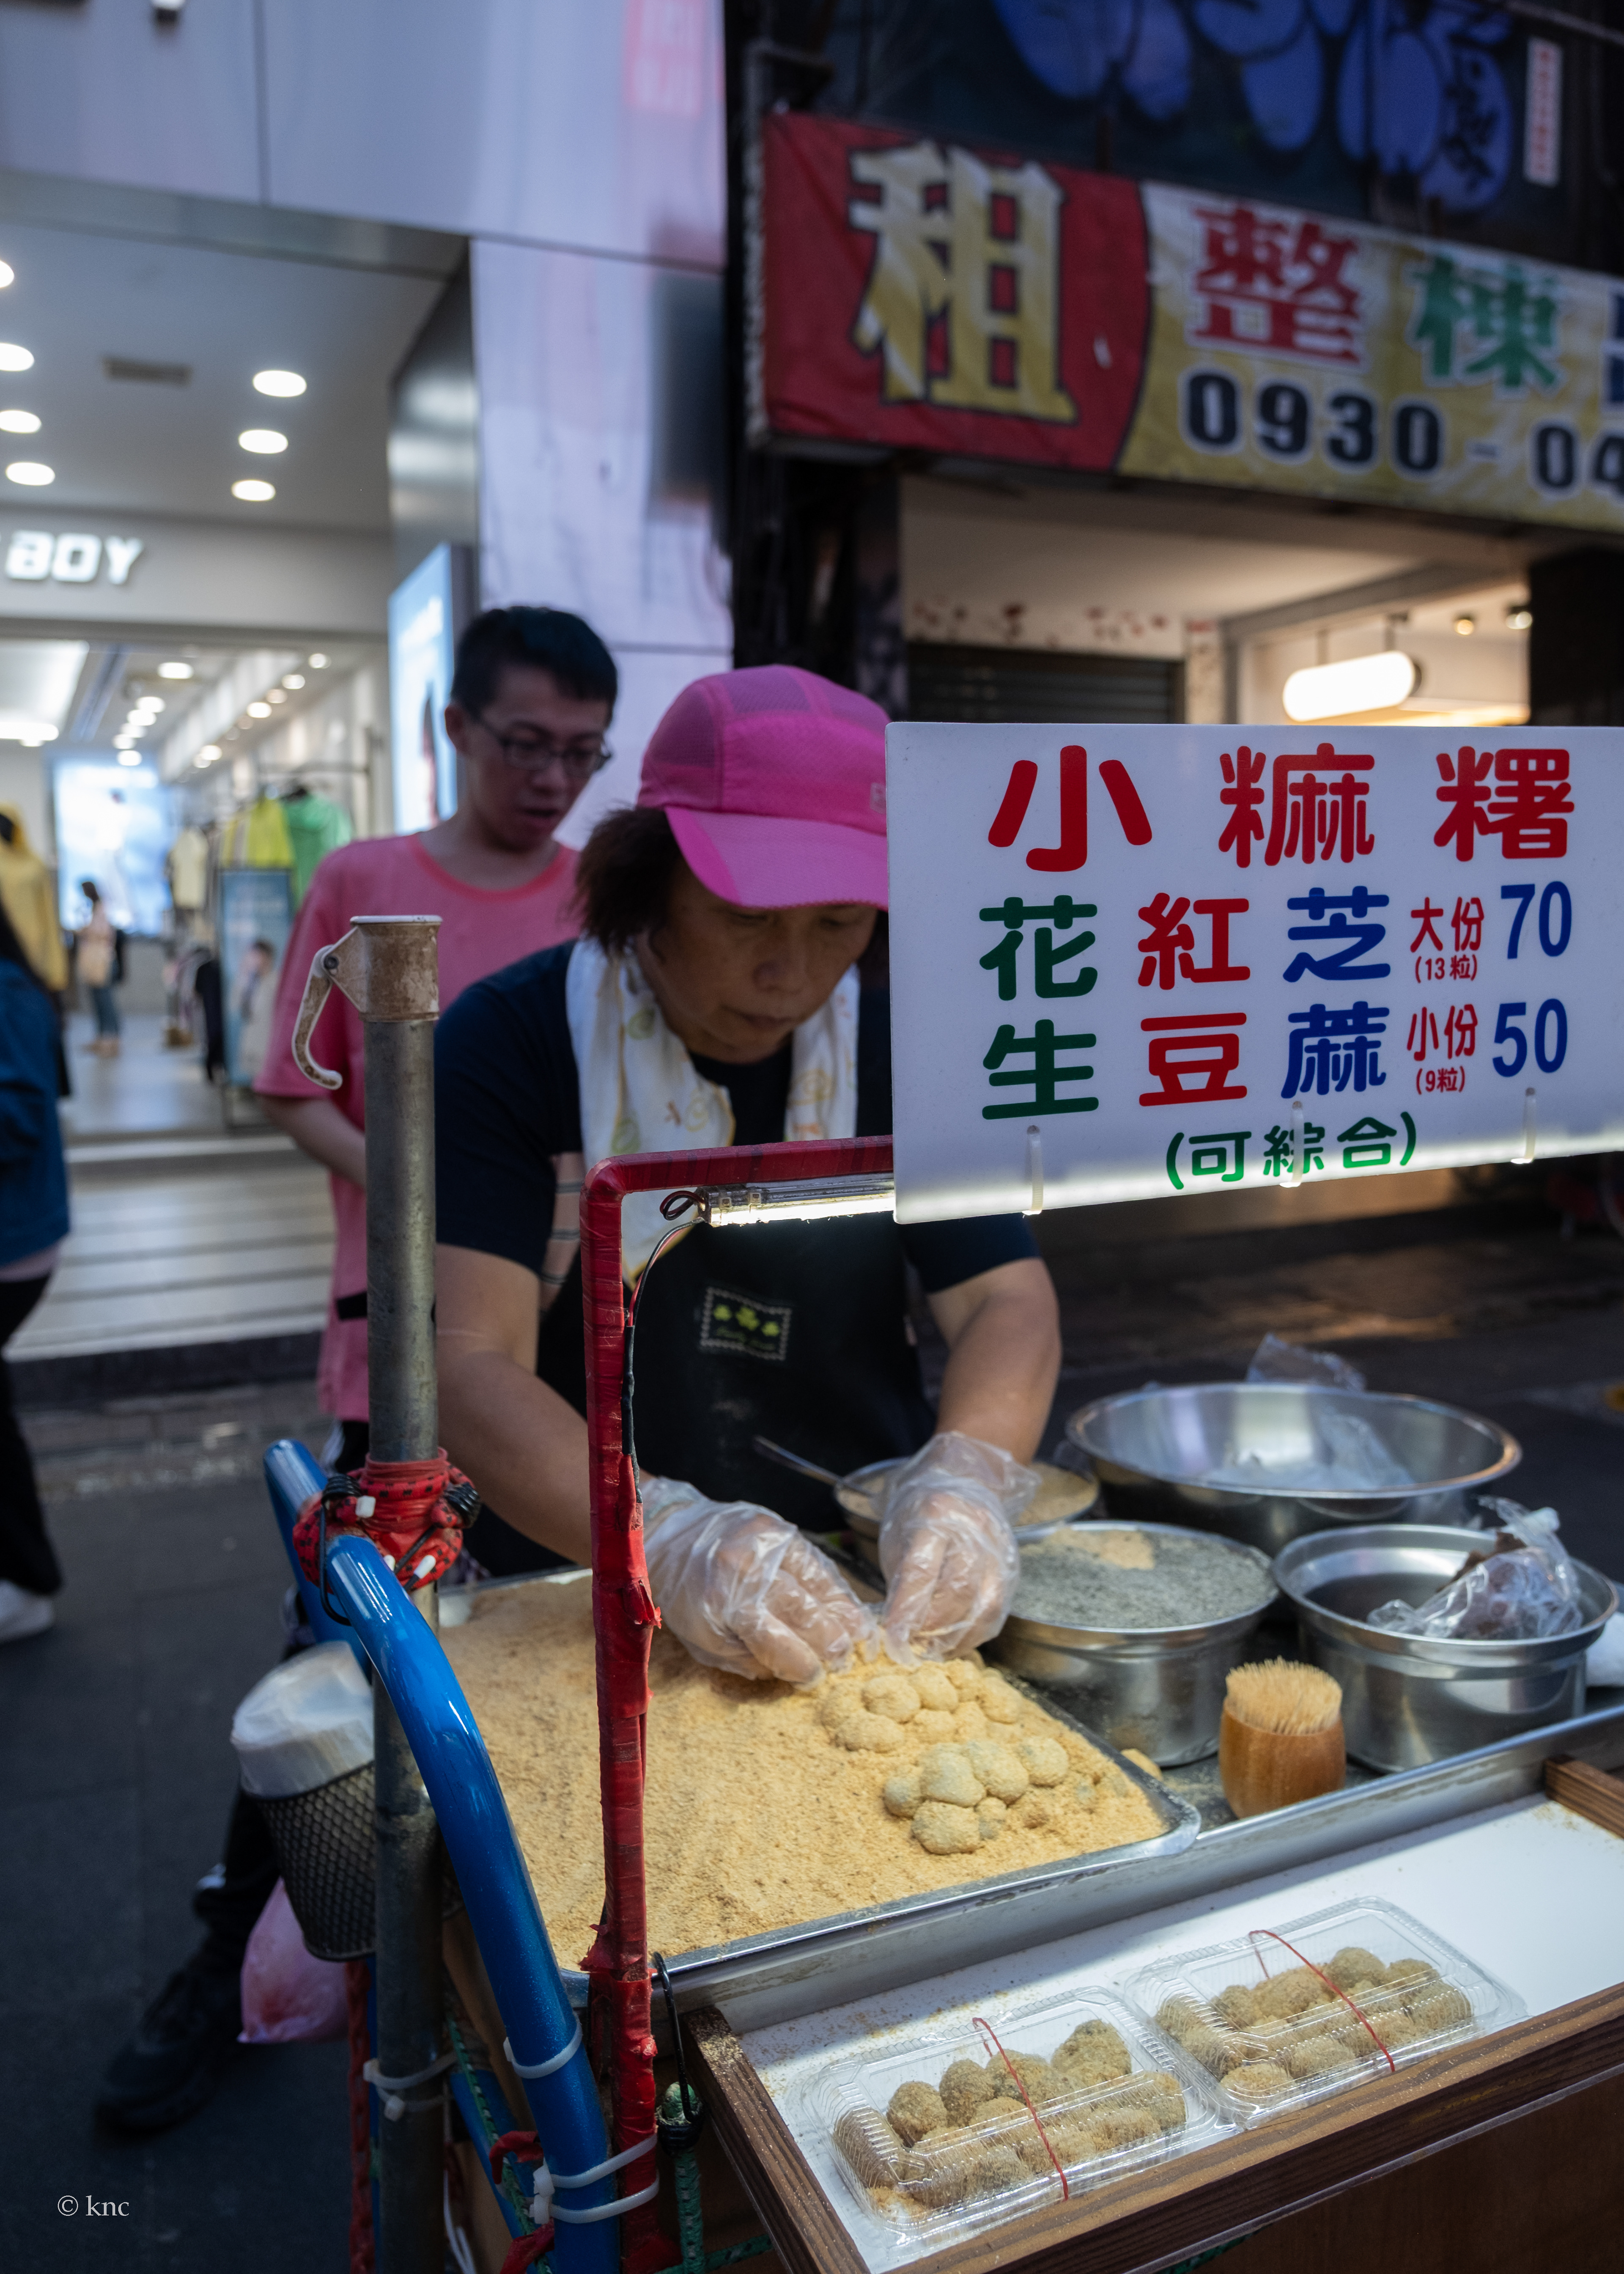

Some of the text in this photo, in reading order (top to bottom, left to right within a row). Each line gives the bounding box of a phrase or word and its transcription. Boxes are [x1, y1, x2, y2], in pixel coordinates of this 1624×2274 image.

[849, 141, 1078, 423] 租
[1193, 203, 1624, 404] 整棟
[6, 530, 144, 585] BOY
[1410, 897, 1484, 953] 大份
[1501, 881, 1572, 959] 70
[1407, 1004, 1478, 1061] 小份
[1492, 998, 1567, 1077] 50
[1416, 1066, 1465, 1095] (9粒)
[1166, 1111, 1417, 1190] (可綜合)
